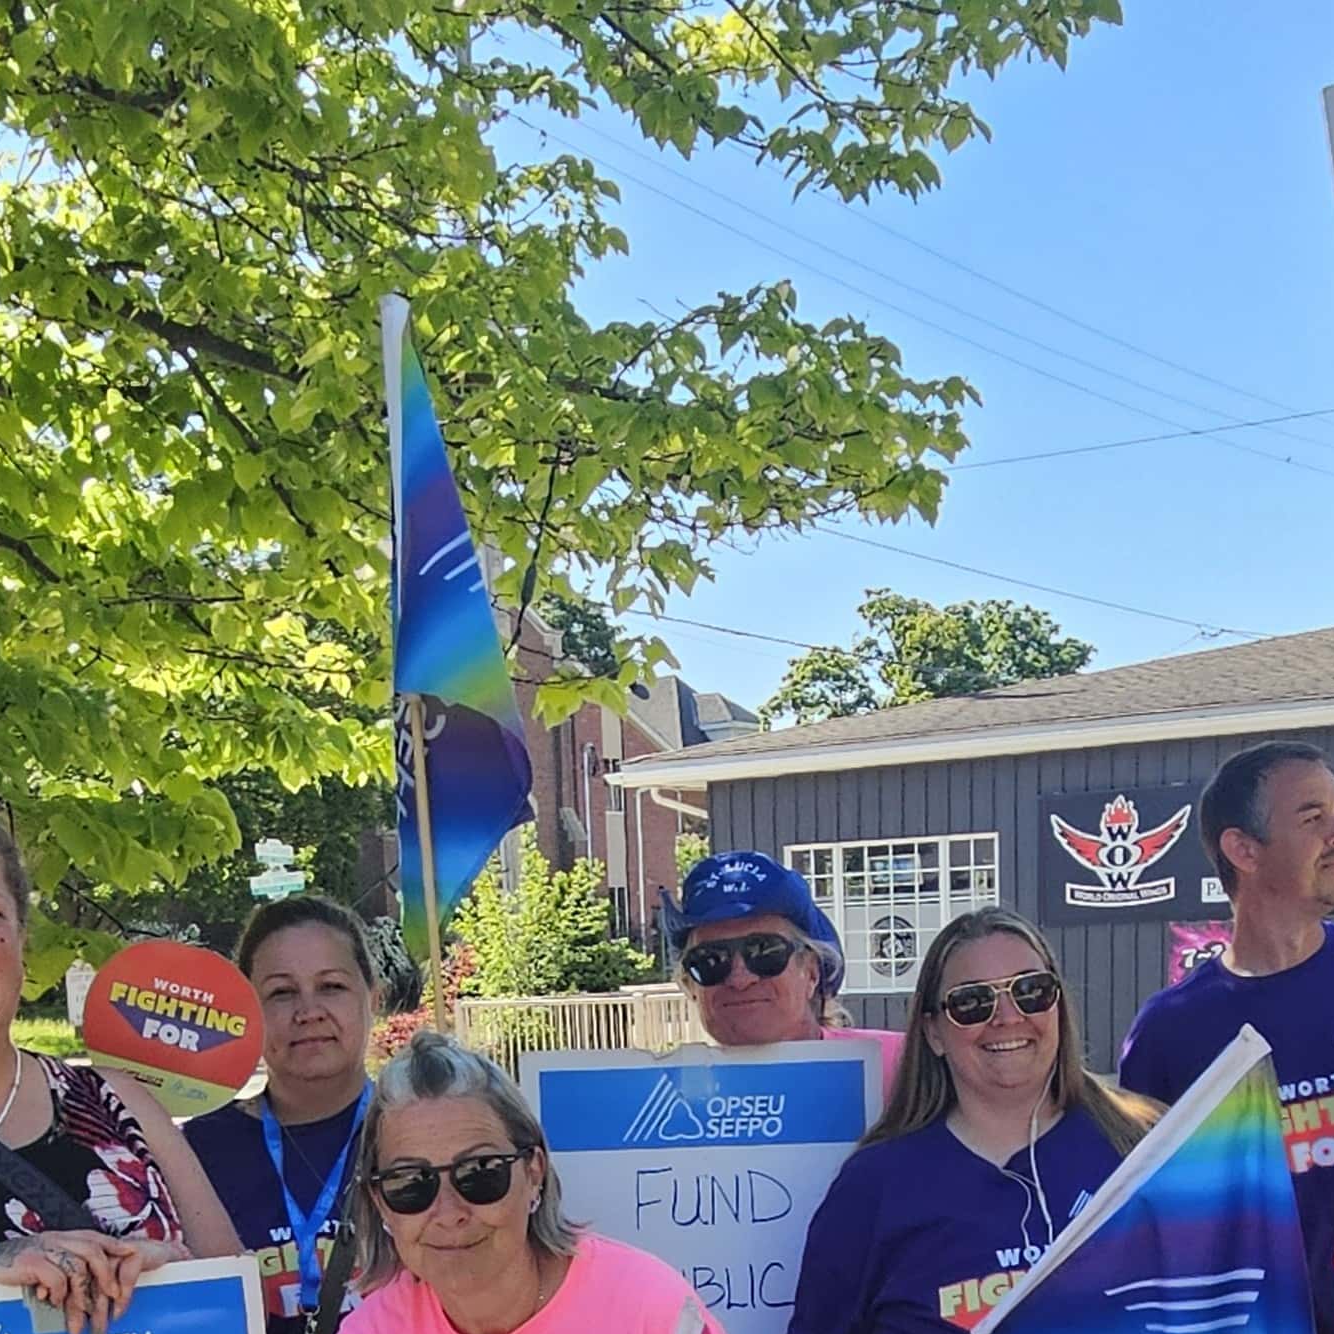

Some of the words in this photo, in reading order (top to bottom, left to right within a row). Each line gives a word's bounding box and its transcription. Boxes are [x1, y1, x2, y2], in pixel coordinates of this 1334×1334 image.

[153, 977, 215, 1005] WORTH
[108, 982, 247, 1038] FIGHTING
[142, 1019, 201, 1052] FOR
[706, 1095, 785, 1117] OPSEU
[705, 1117, 783, 1139] SEFPO
[635, 1168, 793, 1230] FUND
[683, 1261, 797, 1309] BLIC
